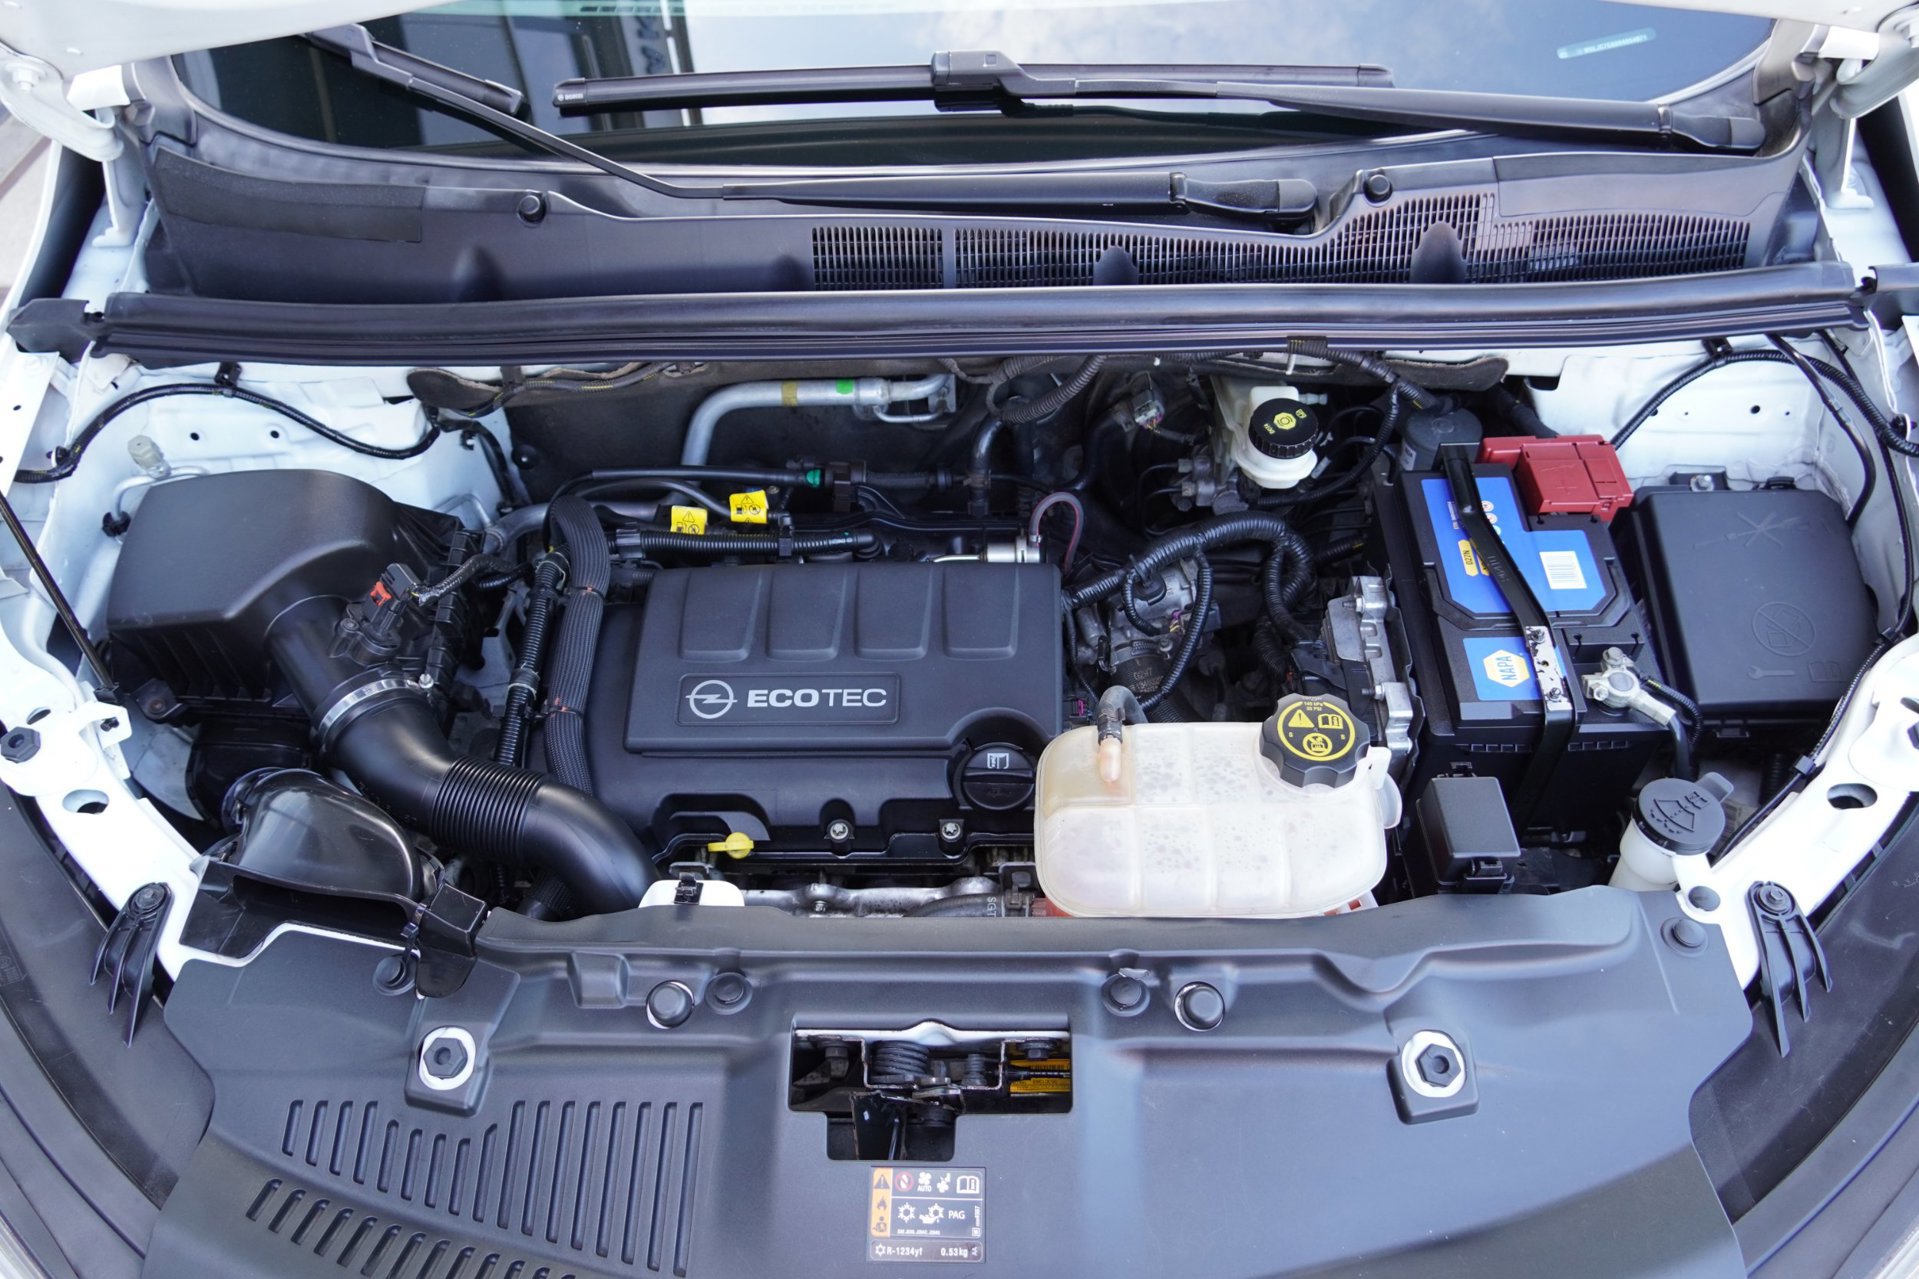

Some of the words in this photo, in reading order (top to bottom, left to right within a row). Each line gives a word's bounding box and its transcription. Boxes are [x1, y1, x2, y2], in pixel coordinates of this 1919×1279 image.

[1496, 656, 1518, 680] NAPA
[746, 688, 887, 708] ECOTEC
[948, 1210, 966, 1220] PAG
